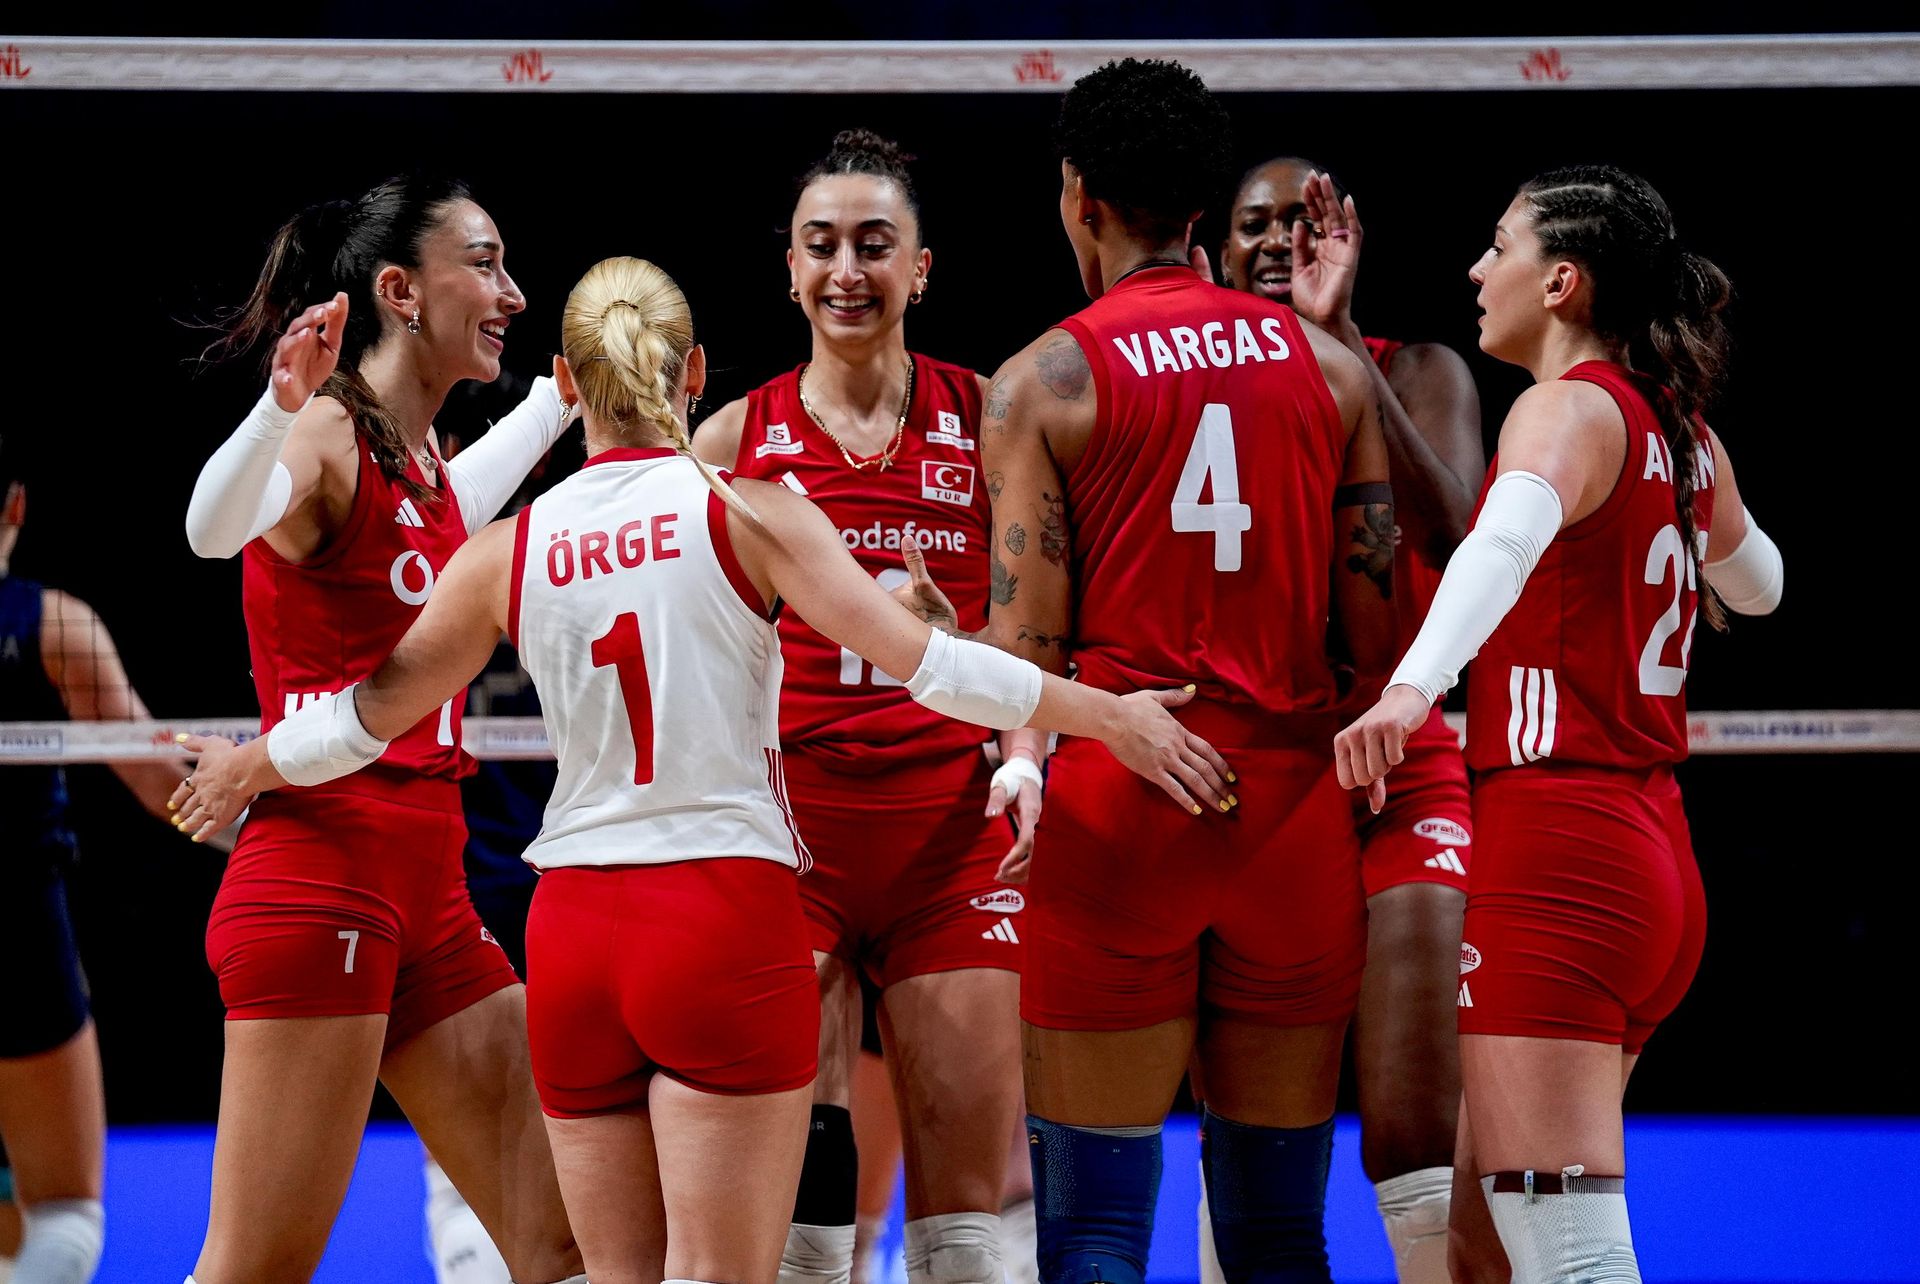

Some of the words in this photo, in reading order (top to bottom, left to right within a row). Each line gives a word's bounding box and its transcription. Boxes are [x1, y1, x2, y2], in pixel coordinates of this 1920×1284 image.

[1112, 317, 1290, 377] VARGAS
[772, 429, 785, 440] S
[944, 416, 955, 429] S
[935, 489, 961, 503] TUR
[1170, 402, 1252, 572] 4
[836, 520, 967, 553] odafone
[547, 513, 681, 588] ÖRGE
[591, 611, 654, 785] 1
[1420, 823, 1466, 840] gratis
[977, 891, 1021, 907] gratis
[338, 930, 360, 974] 7
[1460, 948, 1477, 963] atis
